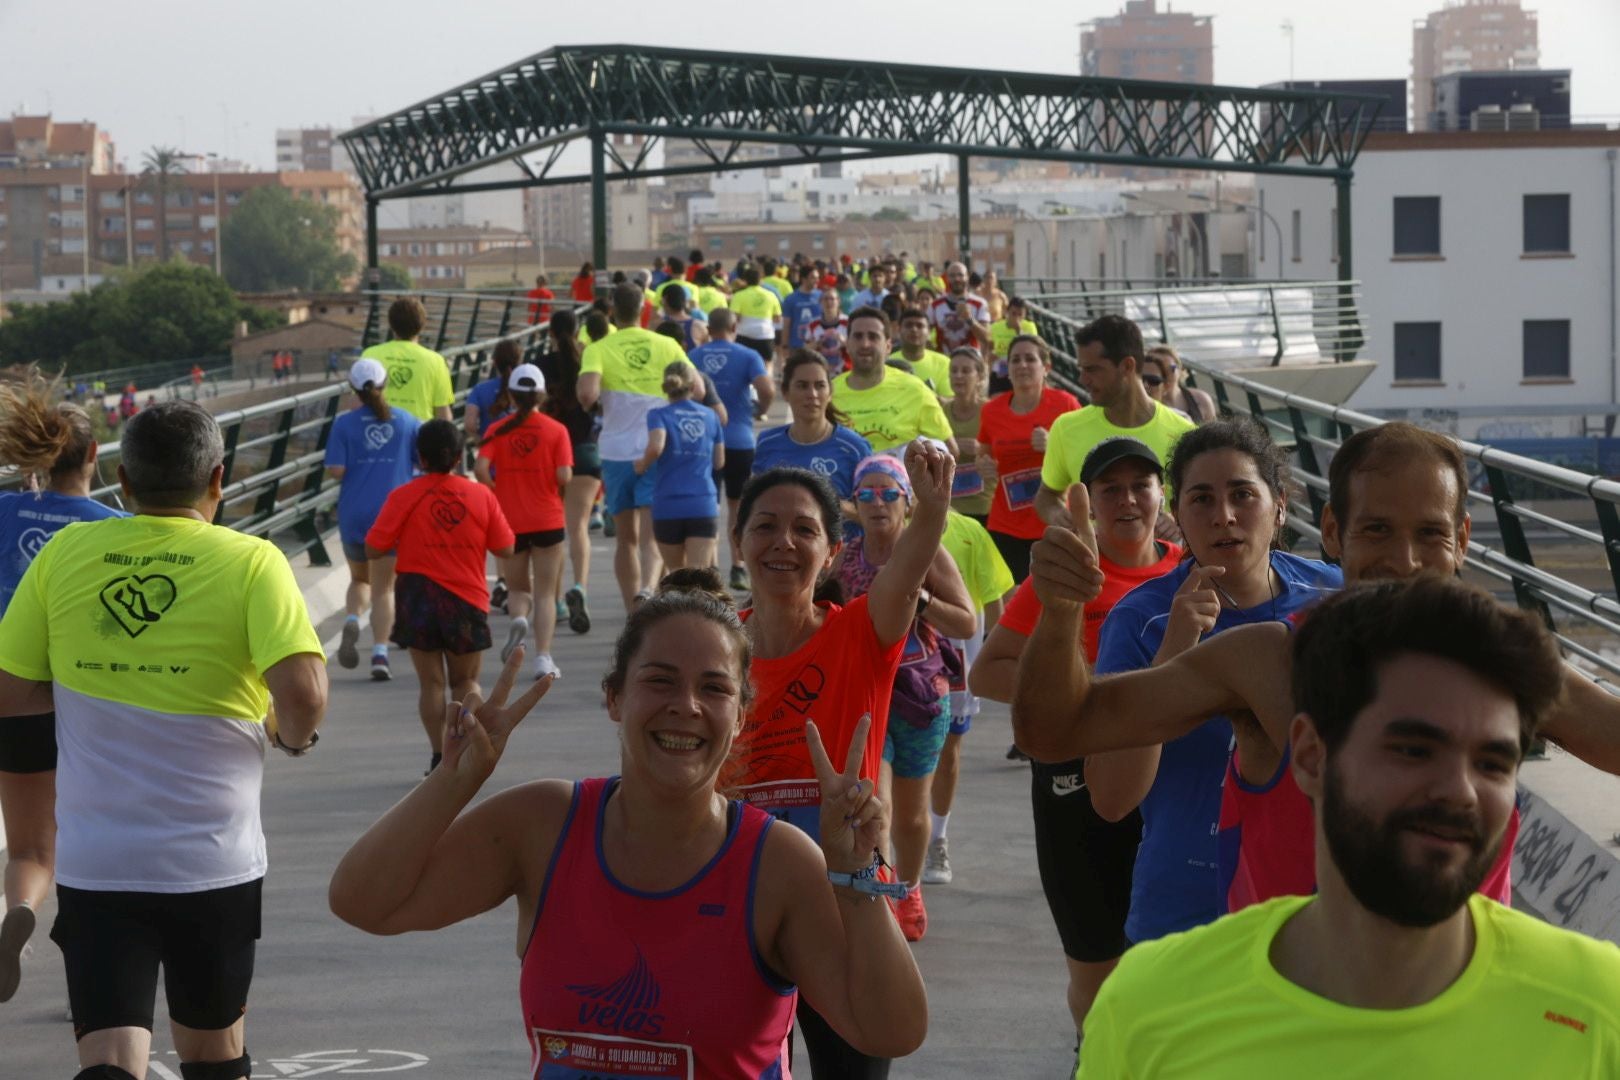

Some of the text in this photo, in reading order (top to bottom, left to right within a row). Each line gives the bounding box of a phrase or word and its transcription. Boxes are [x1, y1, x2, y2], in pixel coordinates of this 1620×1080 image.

[1052, 774, 1079, 787] NIKE
[579, 1001, 665, 1035] velas
[608, 1048, 656, 1064] SOLIDARIDAD
[658, 1052, 677, 1065] 2025
